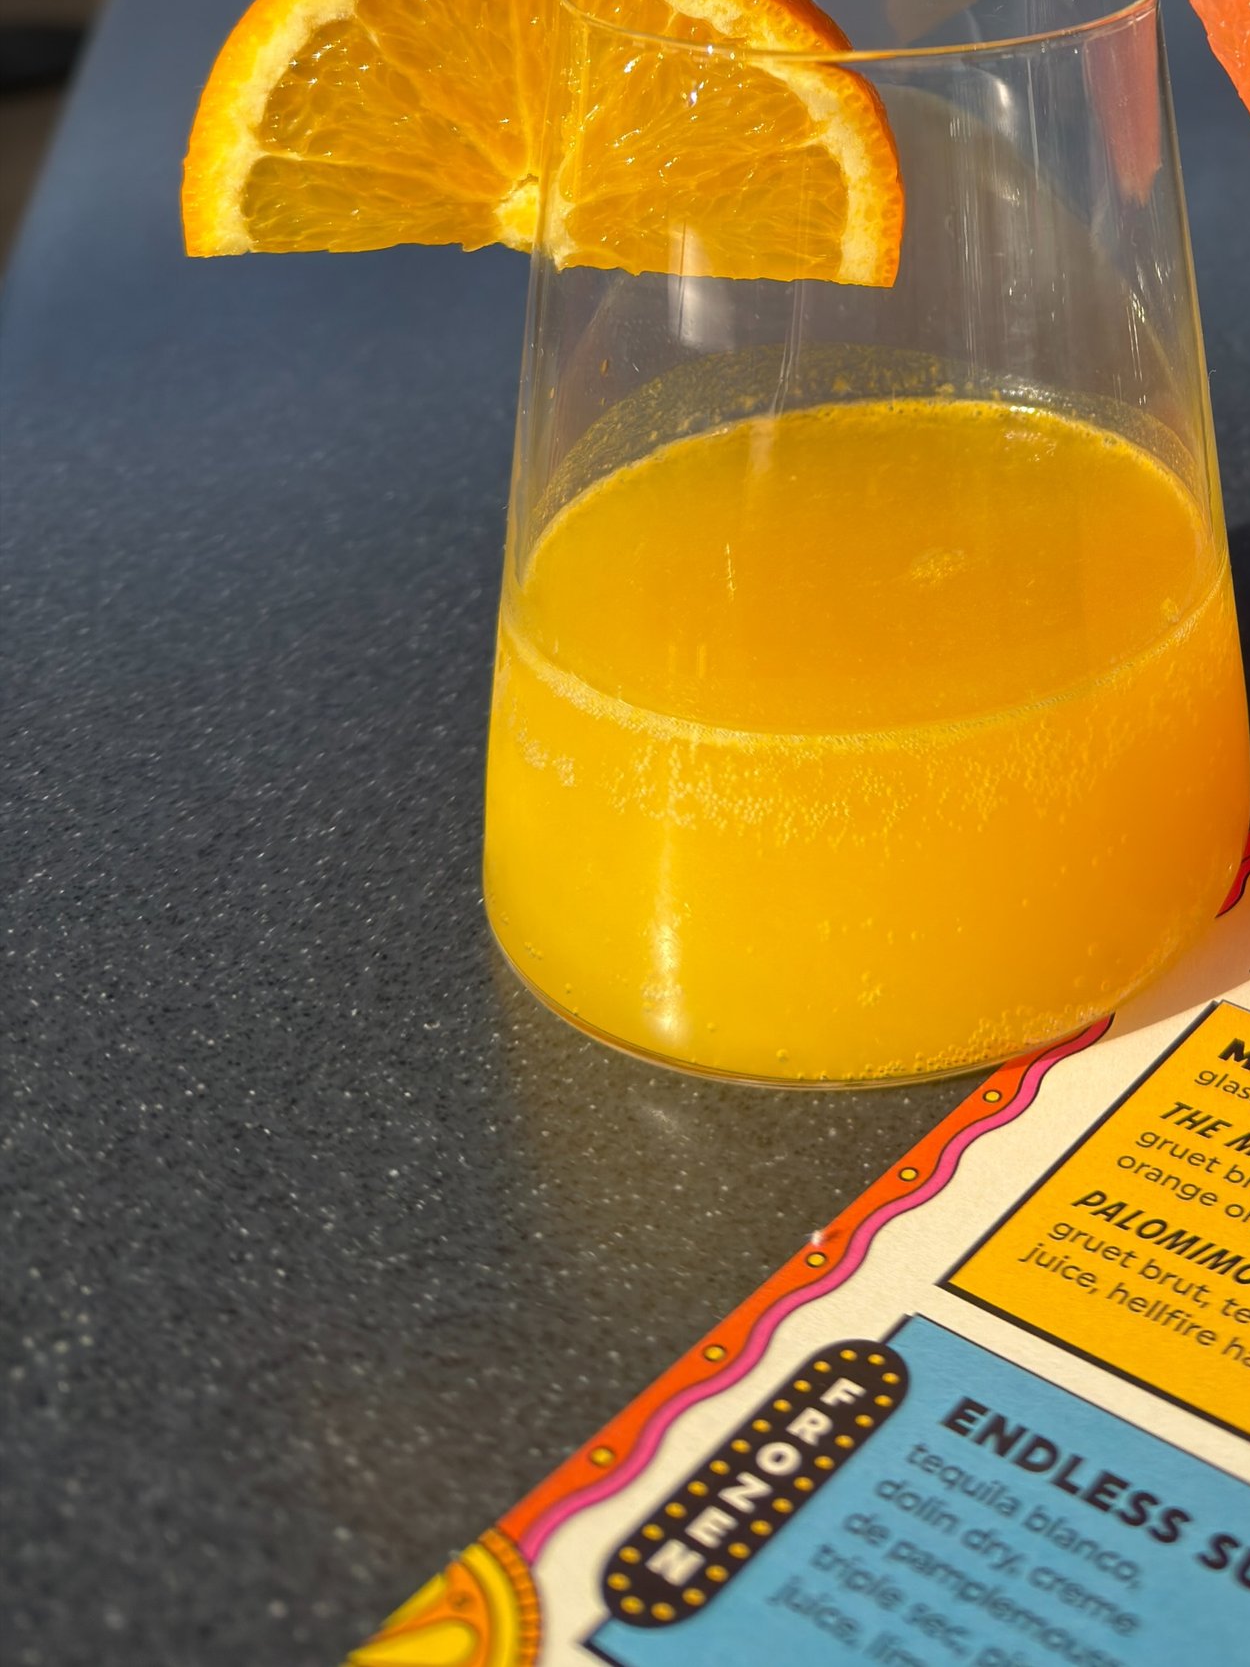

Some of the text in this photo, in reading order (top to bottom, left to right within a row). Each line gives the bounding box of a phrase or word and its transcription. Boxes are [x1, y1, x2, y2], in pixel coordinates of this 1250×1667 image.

[1136, 1131, 1221, 1174] gruet
[1159, 1101, 1233, 1139] THE
[1116, 1154, 1218, 1208] orange
[1019, 1242, 1103, 1295] juice,
[1106, 1282, 1218, 1347] hellfire
[1048, 1221, 1138, 1270] gruet
[1138, 1258, 1211, 1309] brut,
[644, 1377, 866, 1586] FROZEN
[905, 1442, 1022, 1520] tequila
[940, 1395, 1193, 1545] ENDLESS
[841, 1511, 892, 1547] de
[874, 1478, 961, 1534] dolin
